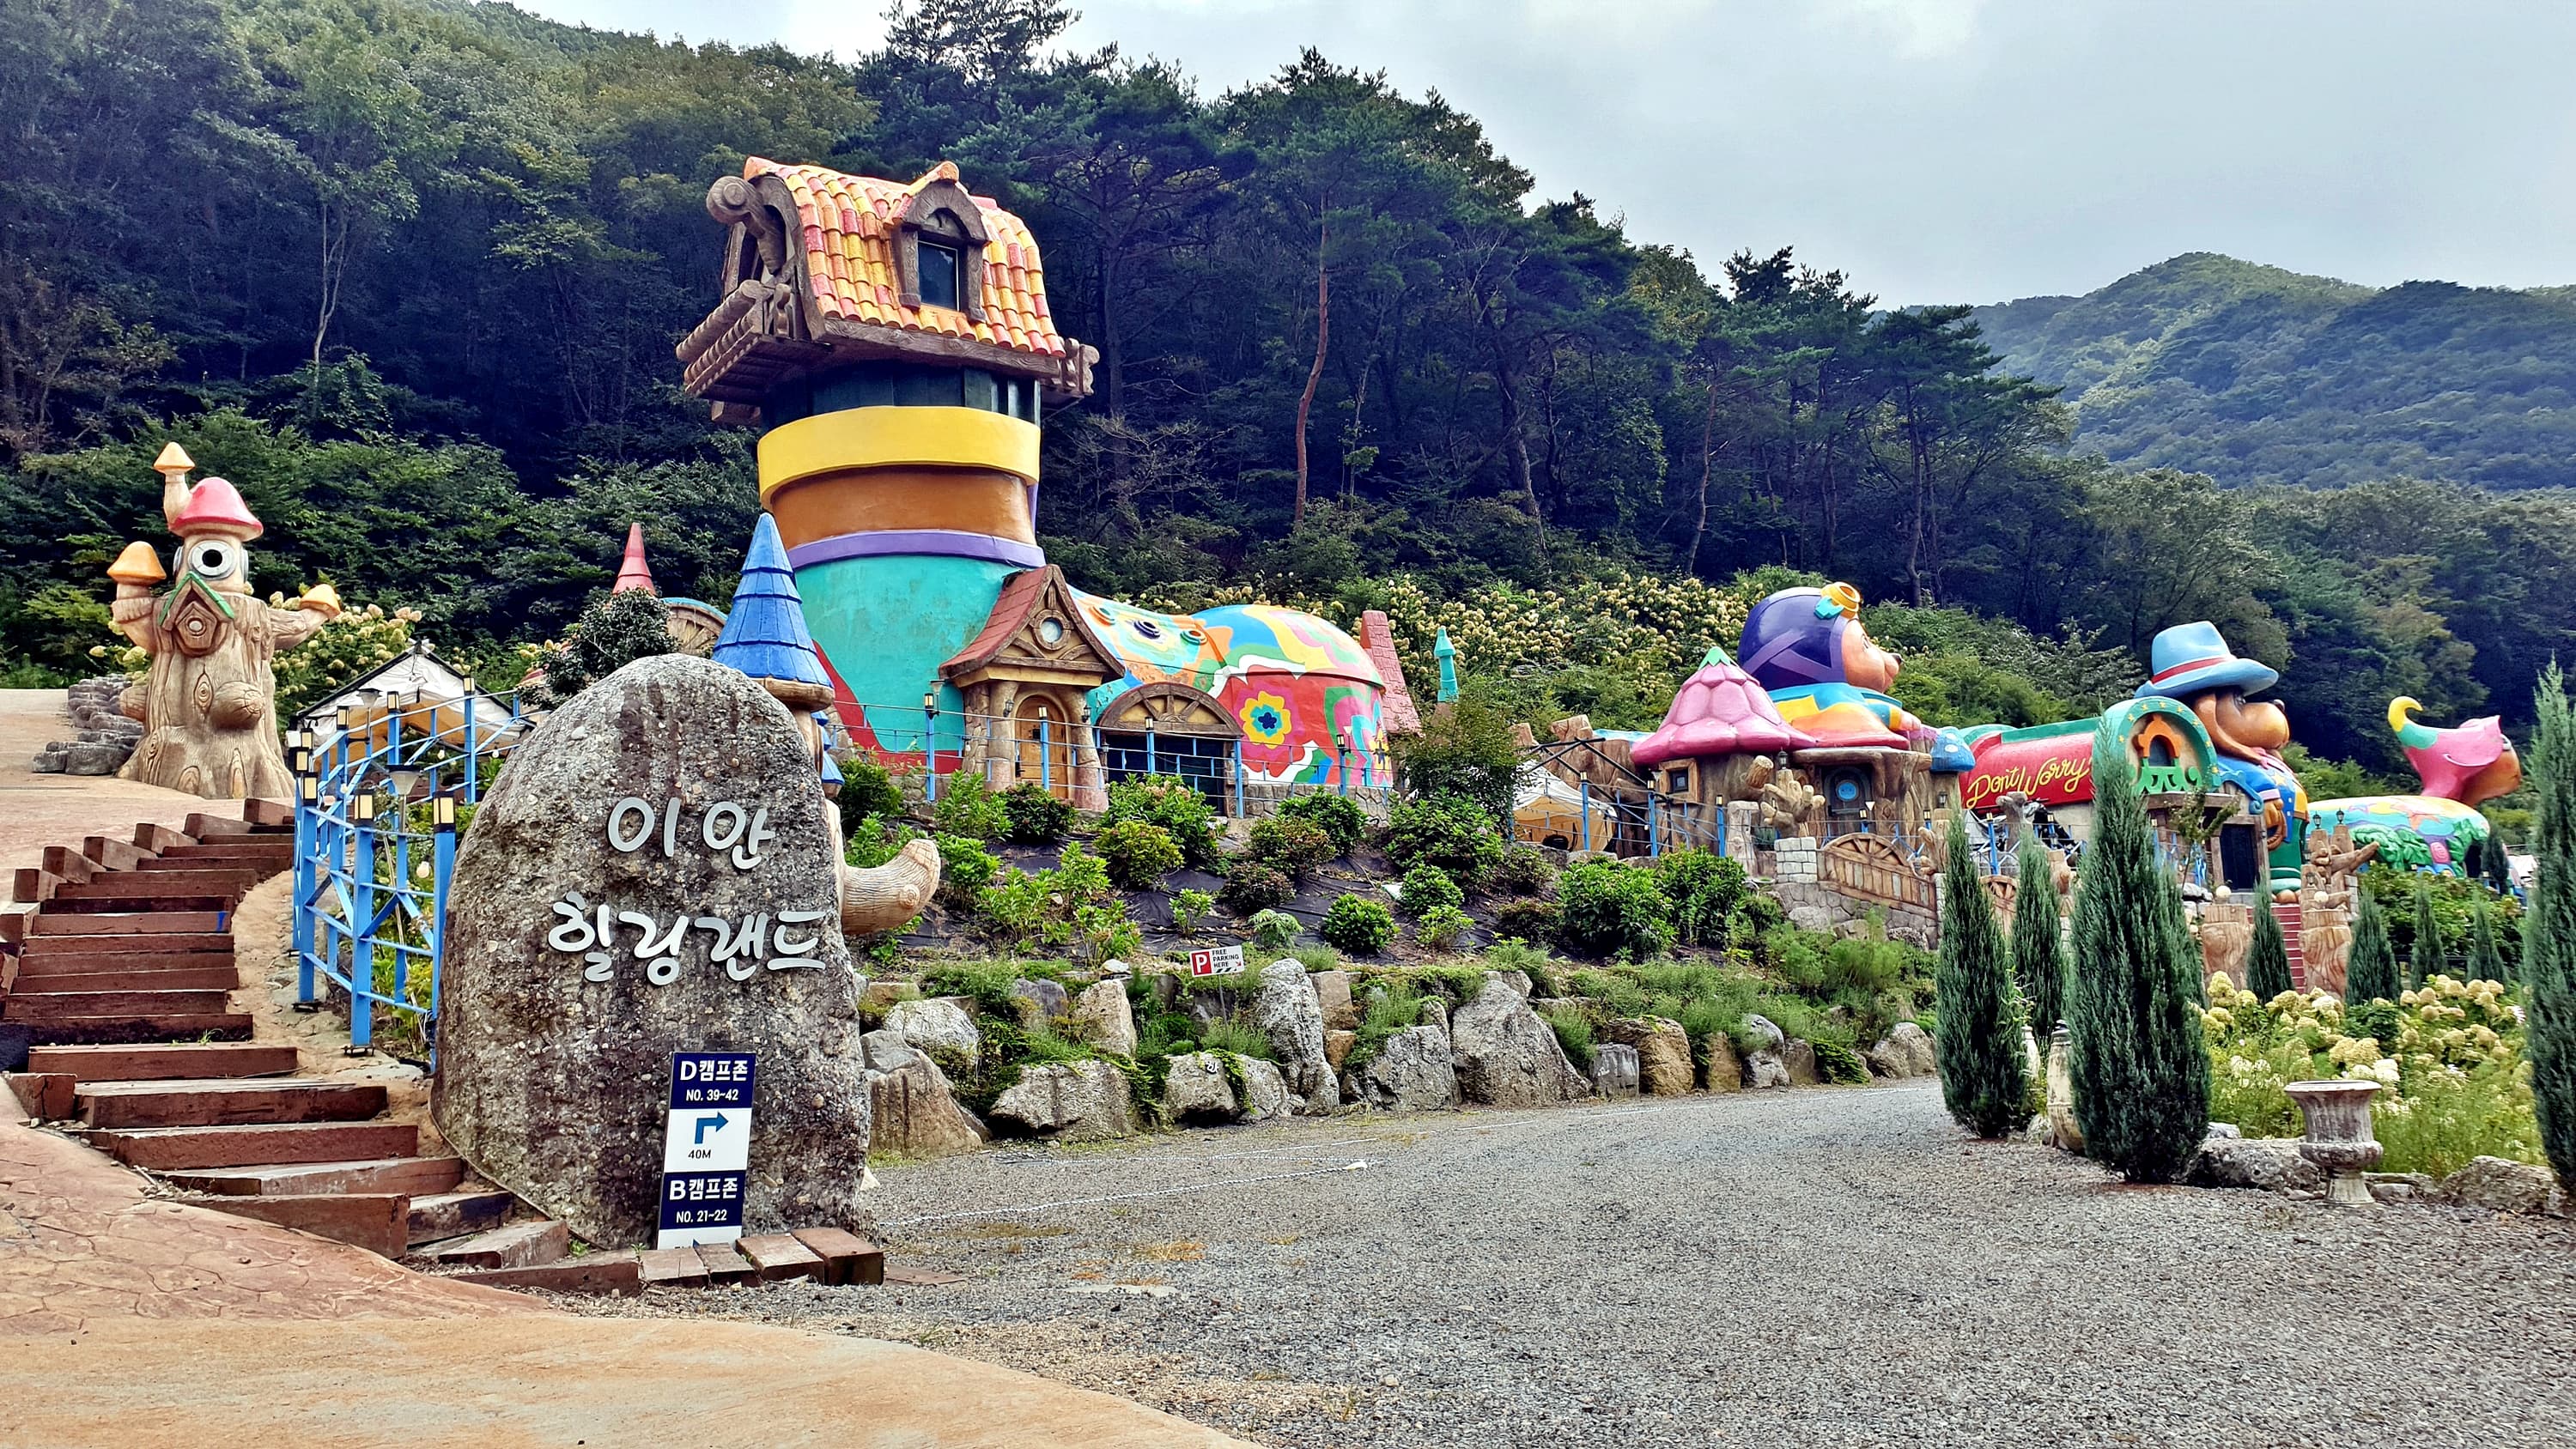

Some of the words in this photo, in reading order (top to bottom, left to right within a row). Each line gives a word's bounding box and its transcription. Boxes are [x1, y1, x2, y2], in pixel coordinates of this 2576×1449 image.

[608, 797, 775, 870] 이안
[548, 891, 826, 985] 힐링랜드
[1195, 954, 1208, 973] P
[679, 1059, 749, 1082] D캠프존
[685, 1088, 704, 1101] NO.
[706, 1088, 739, 1101] 39~42
[687, 1149, 712, 1160] 40M
[669, 1177, 738, 1201] B캠프존
[675, 1210, 694, 1223] NO.
[696, 1209, 728, 1222] 21~22
